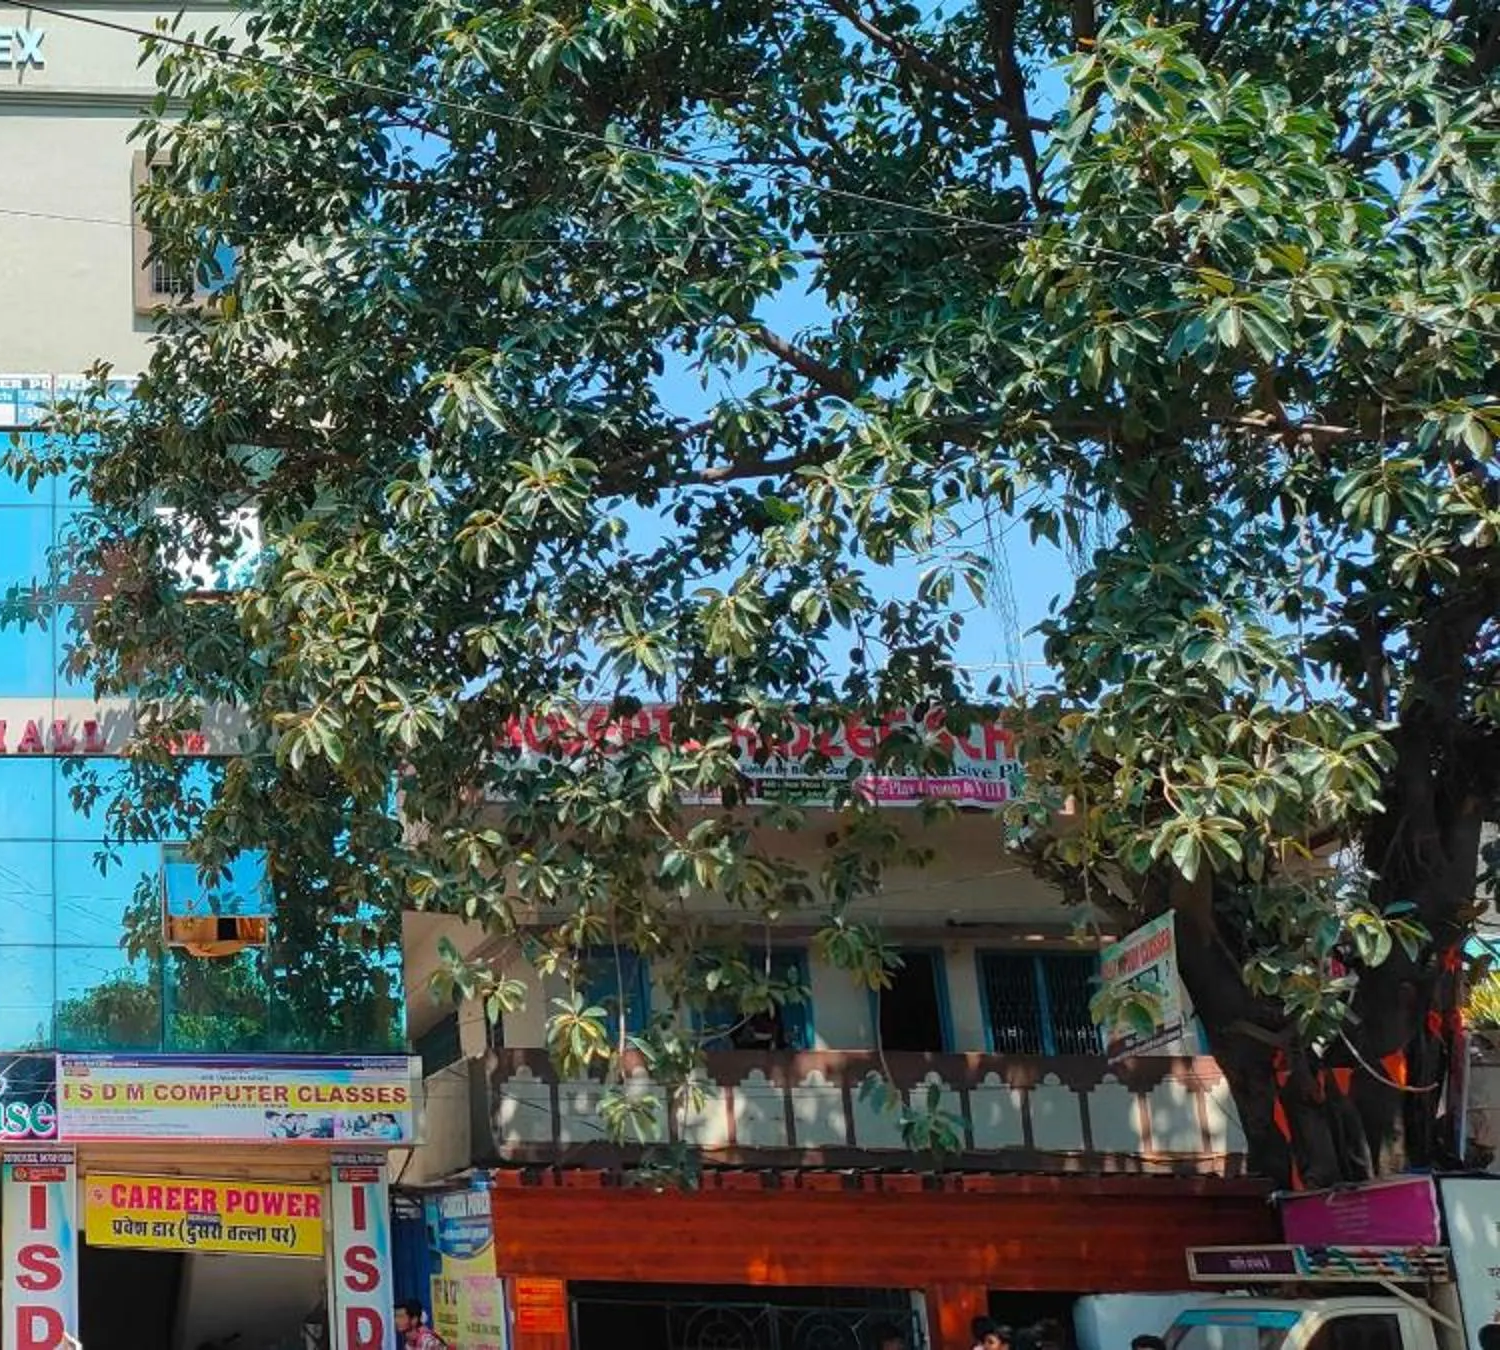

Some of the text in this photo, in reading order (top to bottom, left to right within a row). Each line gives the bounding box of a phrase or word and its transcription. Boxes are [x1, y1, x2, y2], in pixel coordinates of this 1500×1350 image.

[153, 1083, 289, 1103] COMPUTER
[297, 1086, 407, 1105] CLASSES
[111, 1183, 321, 1218] CAREER POWER
[112, 1216, 148, 1236] प्रवेश
